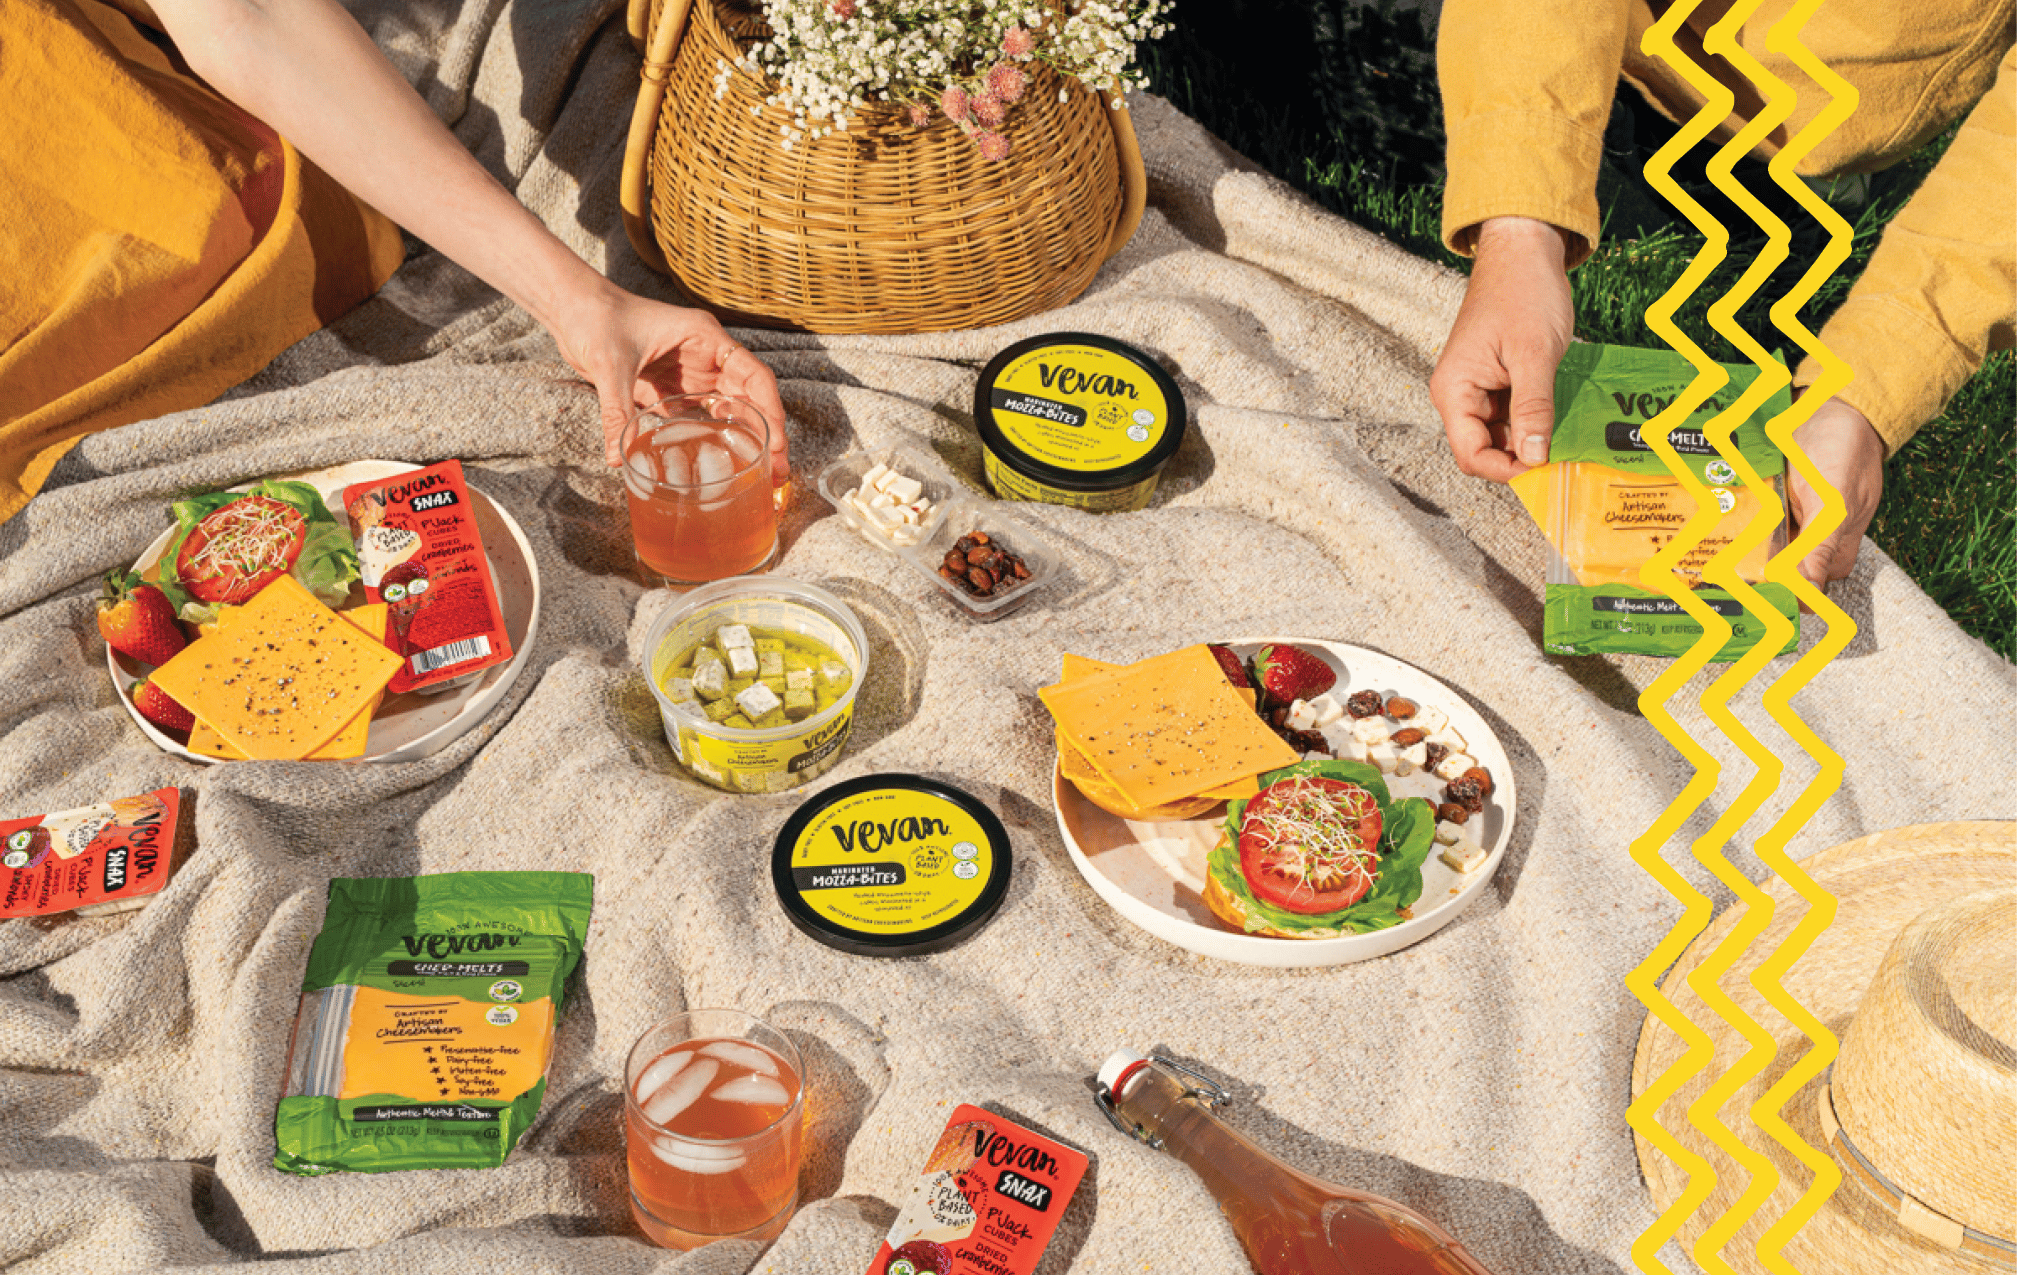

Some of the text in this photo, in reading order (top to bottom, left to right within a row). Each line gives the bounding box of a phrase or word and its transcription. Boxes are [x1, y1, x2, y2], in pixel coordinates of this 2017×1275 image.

[414, 491, 453, 511] SNAX
[106, 850, 127, 887] SNAX
[938, 1186, 980, 1205] PLANT
[999, 1173, 1047, 1207] SNAX
[938, 1198, 972, 1215] BASED
[984, 1223, 1018, 1246] CUBES
[975, 1242, 1007, 1263] DRIED
